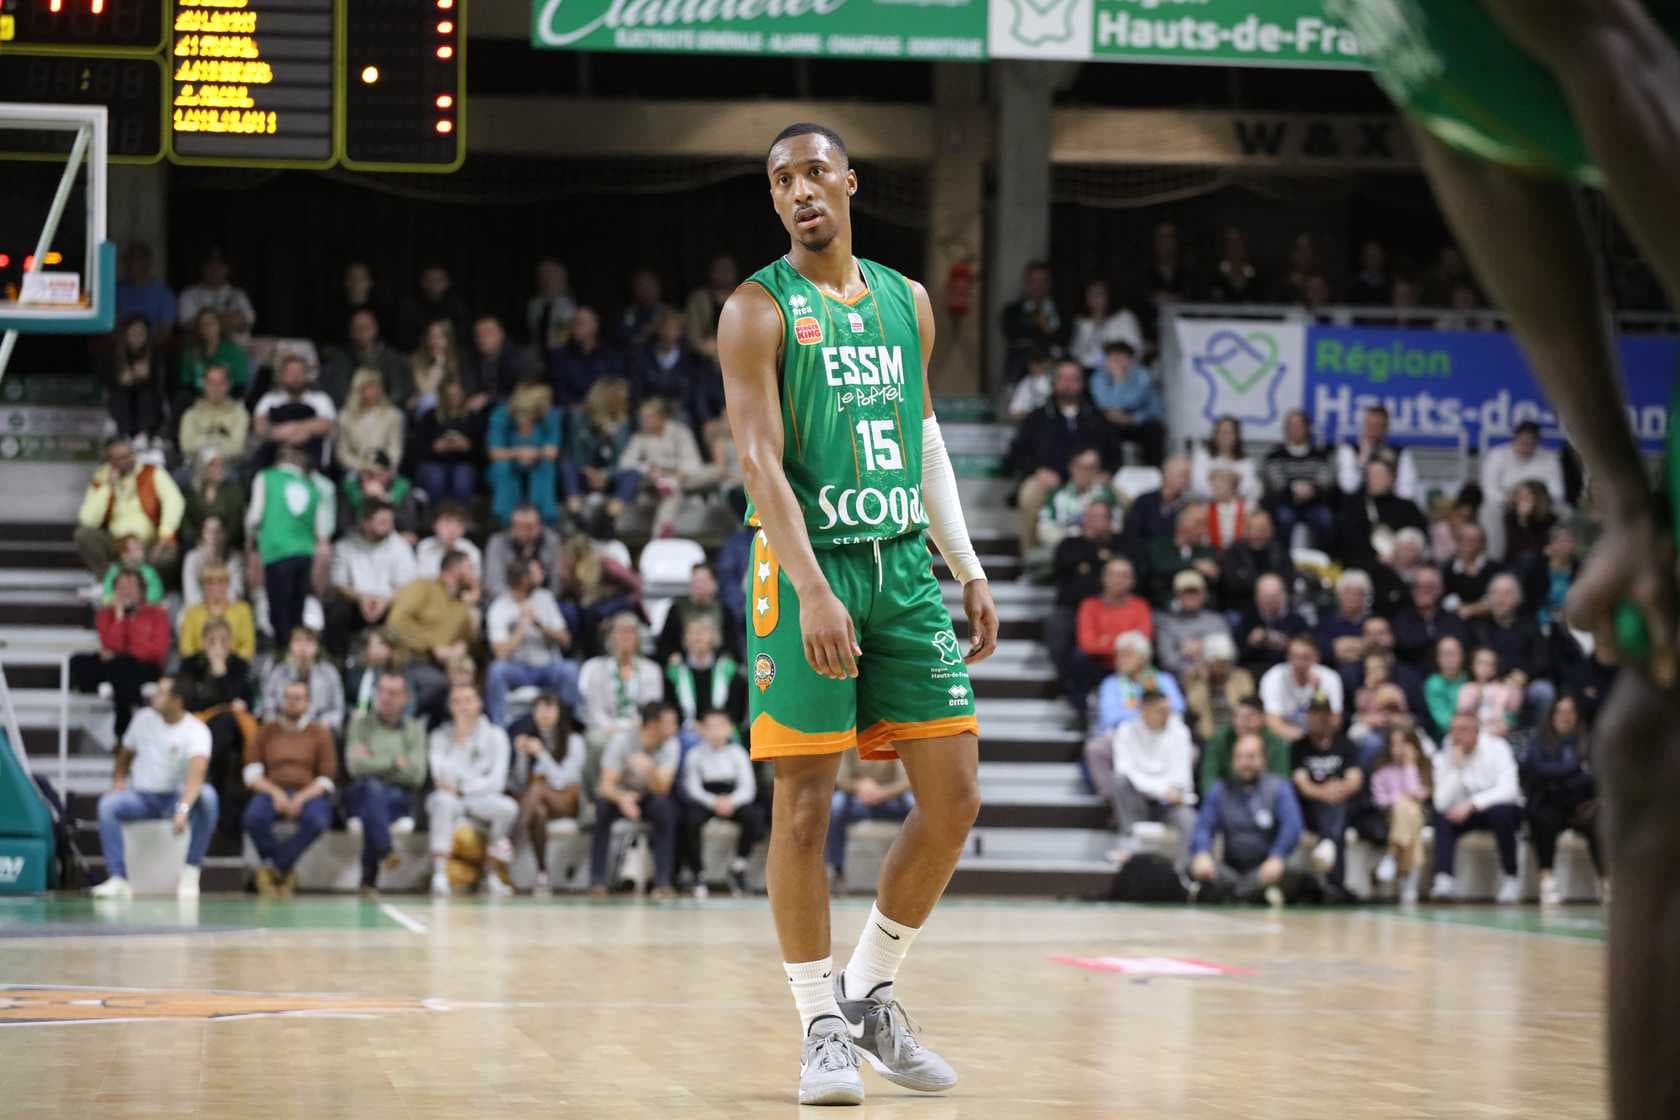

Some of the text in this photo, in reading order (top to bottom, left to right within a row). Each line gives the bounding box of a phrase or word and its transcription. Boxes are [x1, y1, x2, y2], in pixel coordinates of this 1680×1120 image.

[797, 330, 822, 340] KING
[821, 345, 904, 386] ESSM
[1315, 340, 1450, 382] Région
[856, 419, 904, 471] 15
